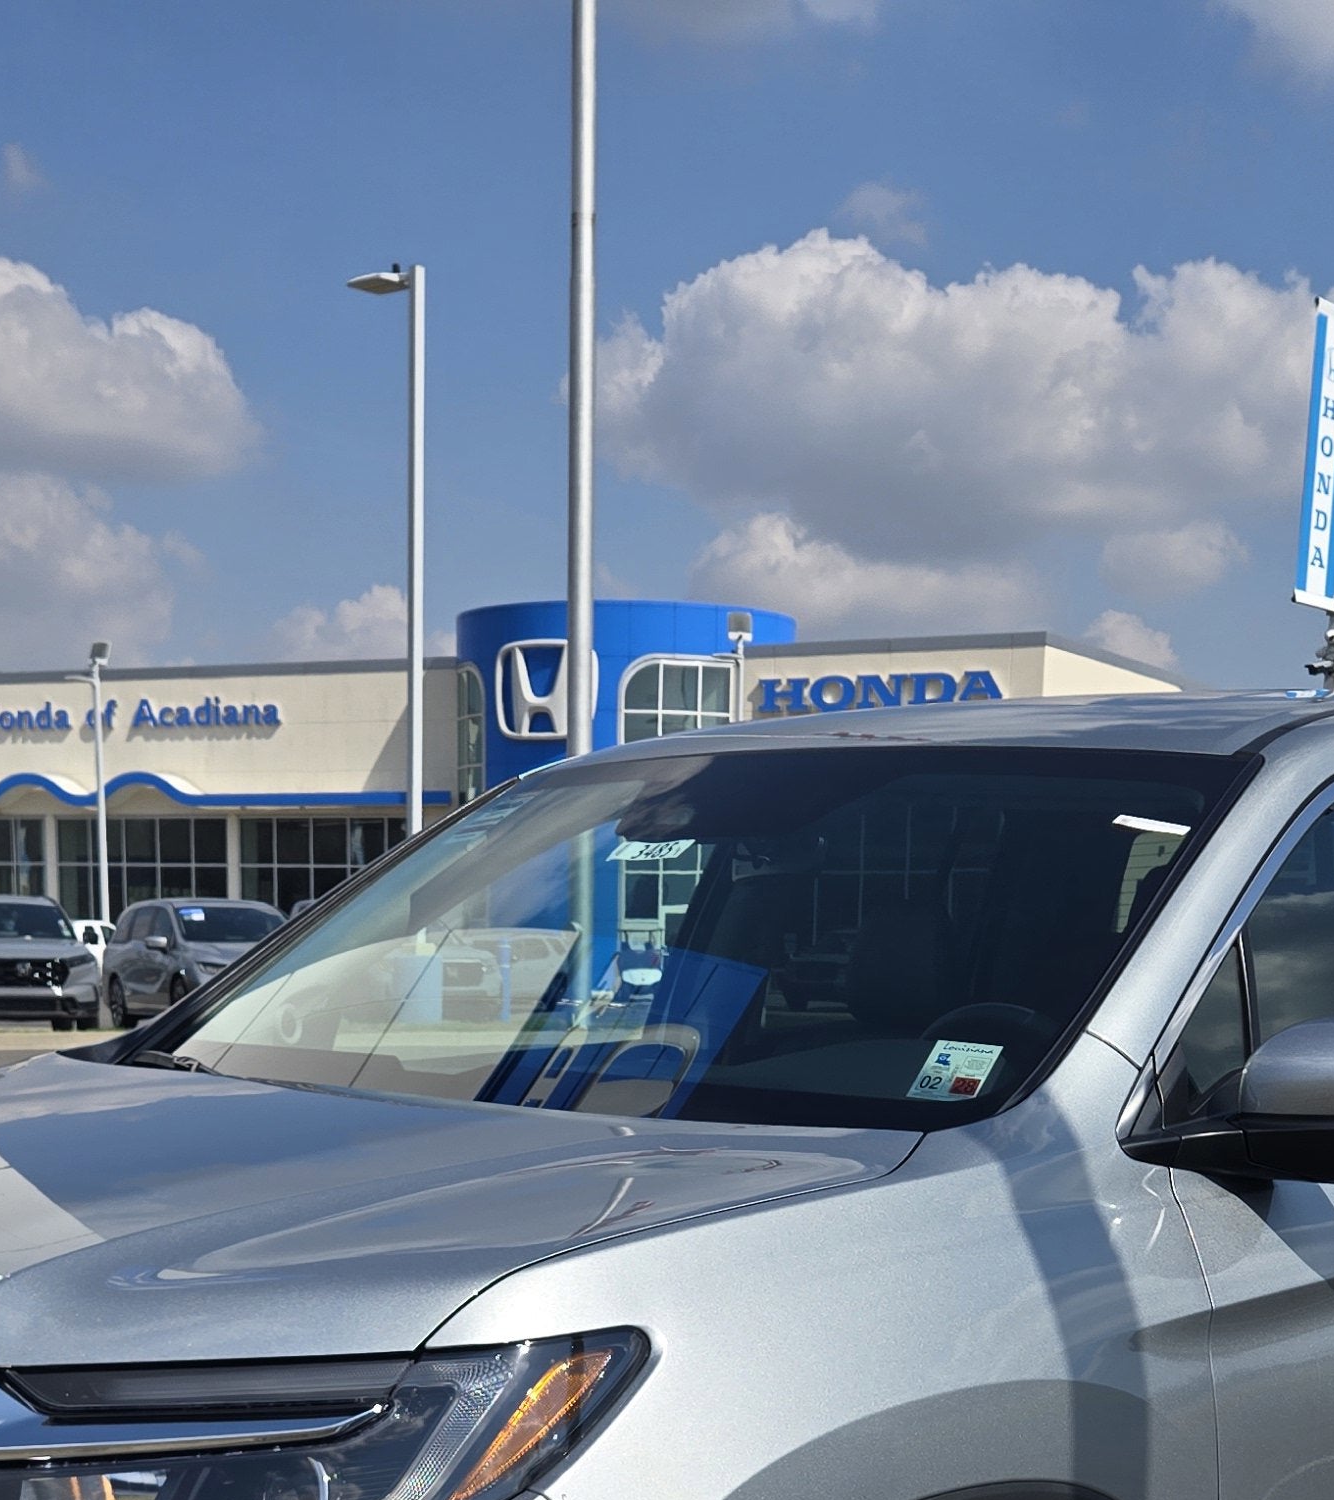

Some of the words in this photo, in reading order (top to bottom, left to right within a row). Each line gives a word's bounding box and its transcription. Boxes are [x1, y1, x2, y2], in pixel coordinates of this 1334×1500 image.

[758, 671, 1003, 713] HONDA
[86, 699, 117, 729] of
[132, 696, 282, 728] Acadiana
[630, 841, 680, 860] 3485
[919, 1075, 943, 1090] 02
[954, 1079, 977, 1095] 28
